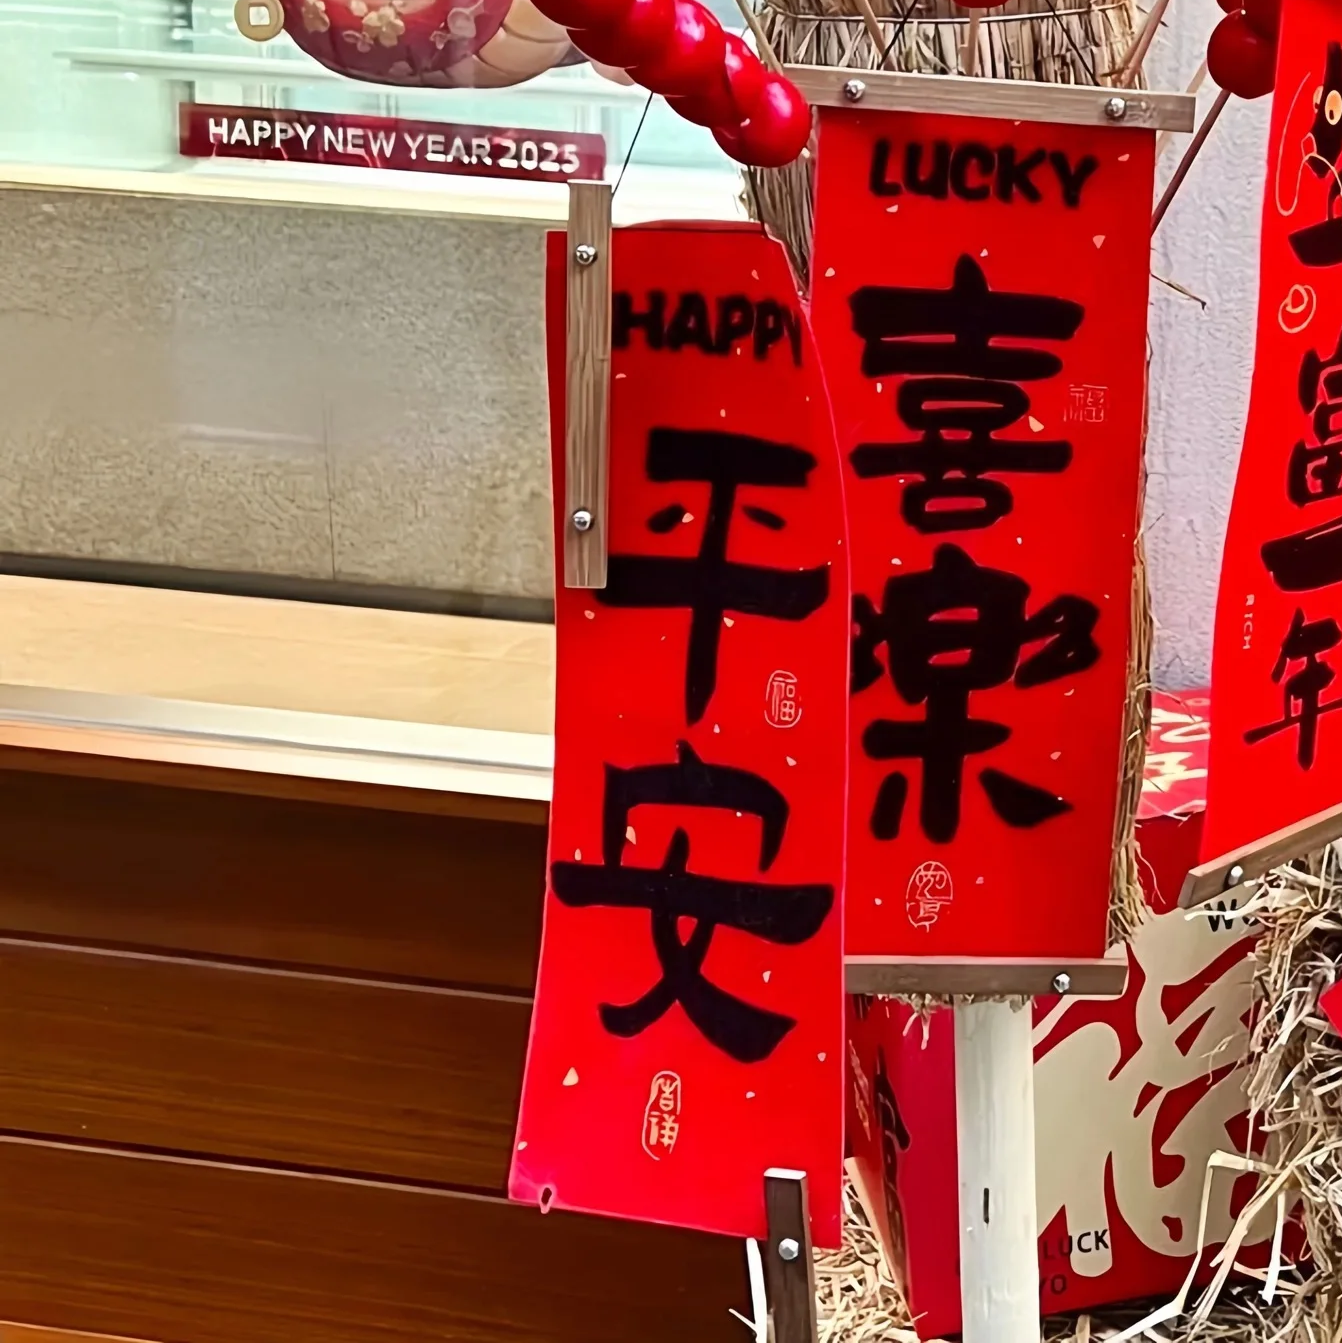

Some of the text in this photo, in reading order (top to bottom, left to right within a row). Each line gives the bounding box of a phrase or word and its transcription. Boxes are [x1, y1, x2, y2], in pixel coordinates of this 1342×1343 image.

[207, 117, 581, 174] HAPPY NEW YEAR 2025
[868, 137, 1100, 208] LUCKY
[551, 426, 835, 1064] 平安
